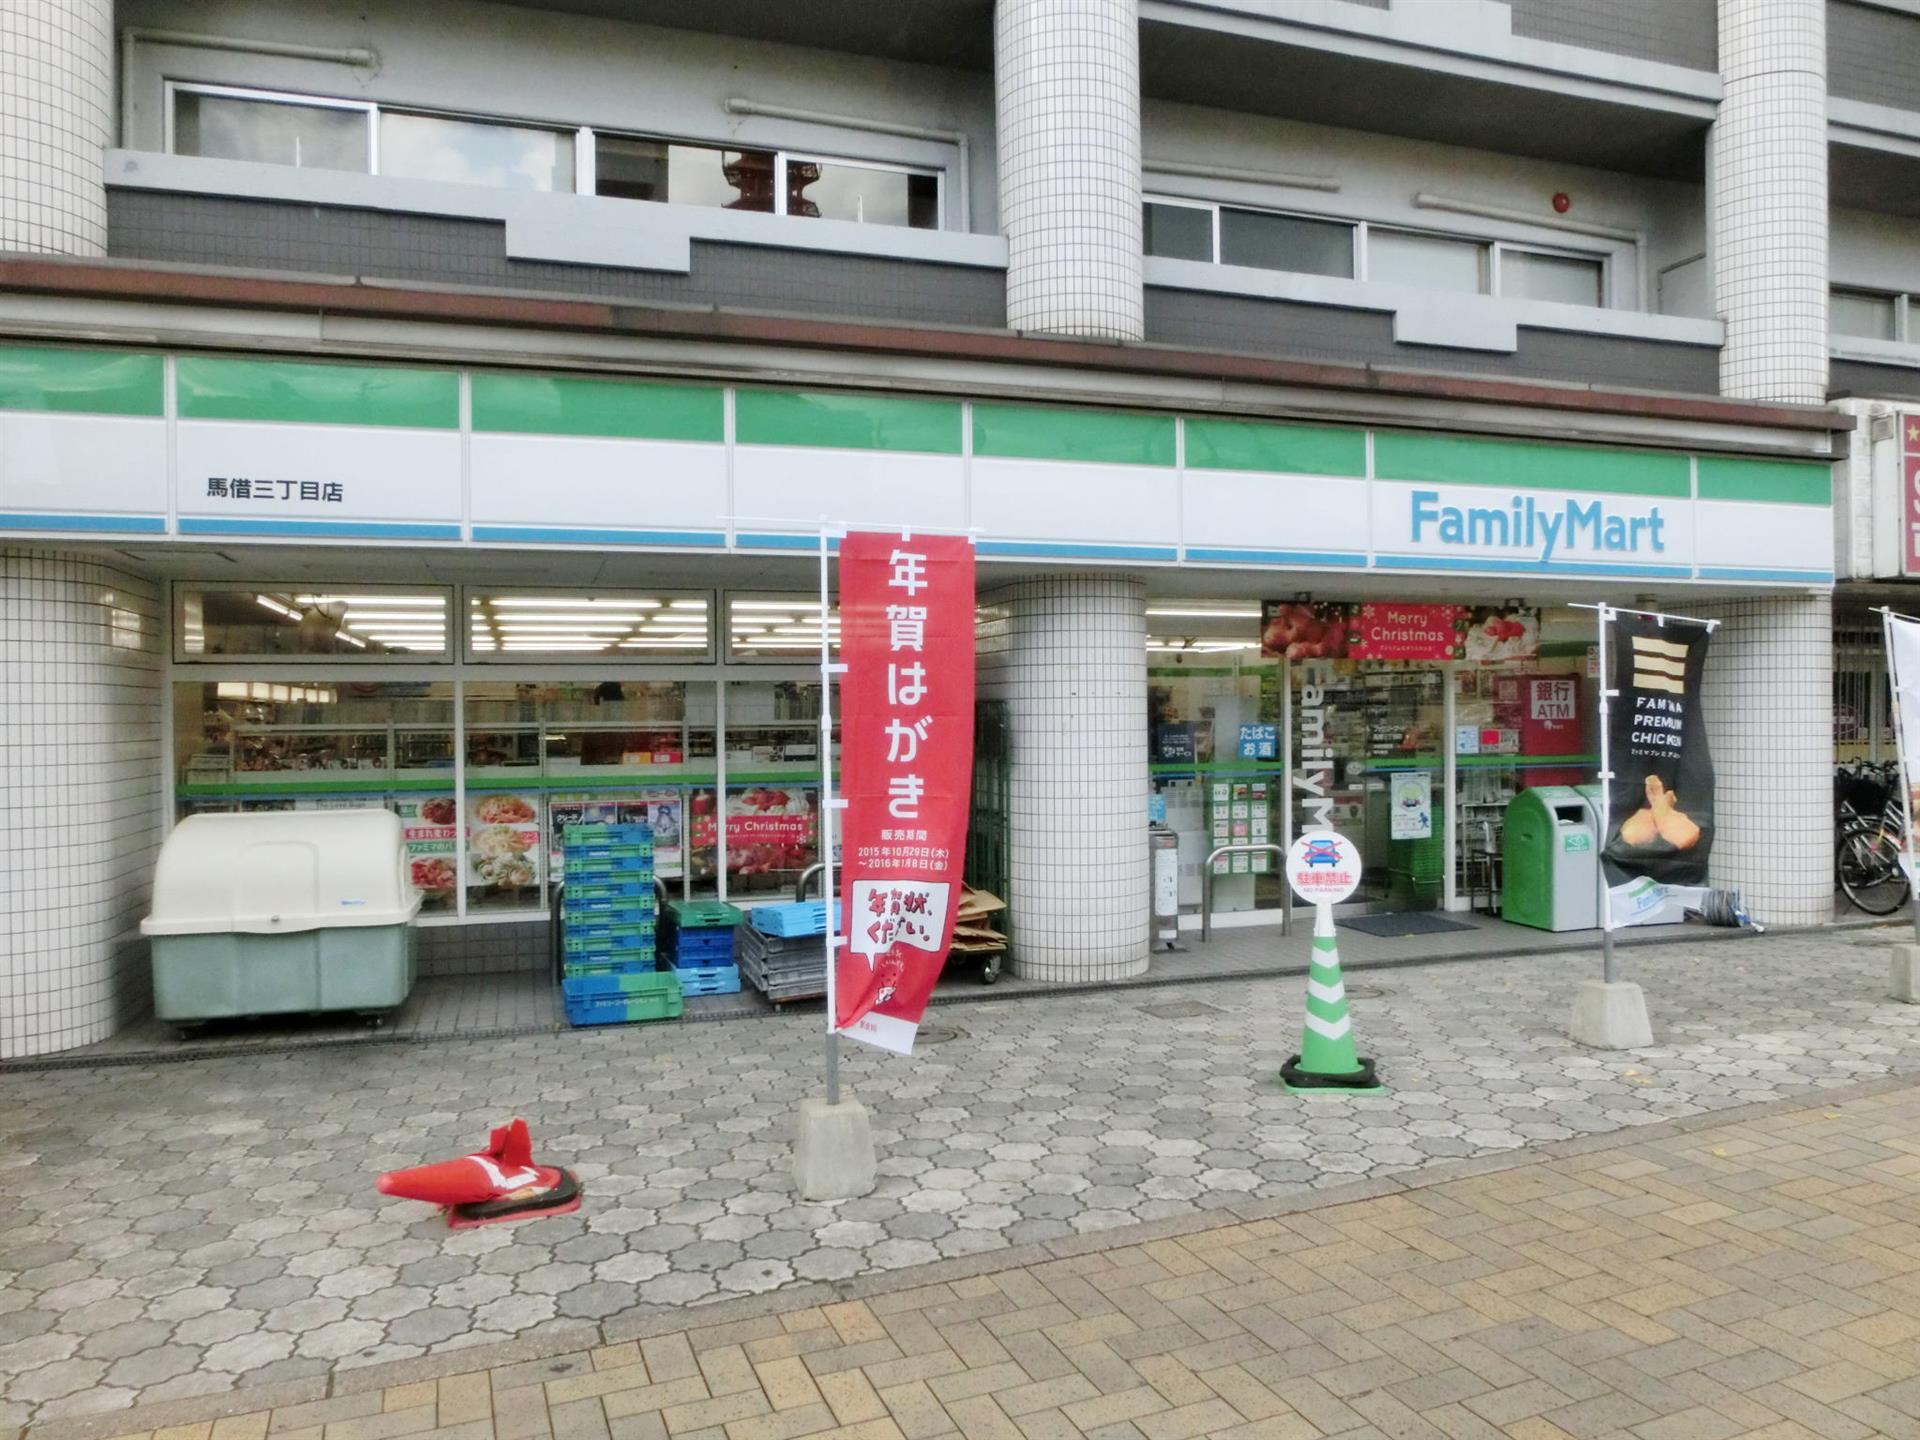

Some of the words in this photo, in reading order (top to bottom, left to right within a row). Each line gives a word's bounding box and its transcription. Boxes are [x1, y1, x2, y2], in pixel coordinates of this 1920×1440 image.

[207, 477, 343, 502] 馬借三丁目店
[1411, 490, 1665, 562] FamilyMart
[1387, 611, 1428, 627] Merry
[1371, 627, 1444, 641] Christmas
[884, 549, 933, 818] 年賀はがき
[1536, 682, 1570, 701] 銀行
[1537, 704, 1570, 718] ATM
[1240, 726, 1275, 740] たばこ
[1243, 742, 1272, 756] お酒
[708, 823, 740, 832] Mrry
[744, 821, 803, 831] Christmas
[881, 829, 928, 841] 販売期間
